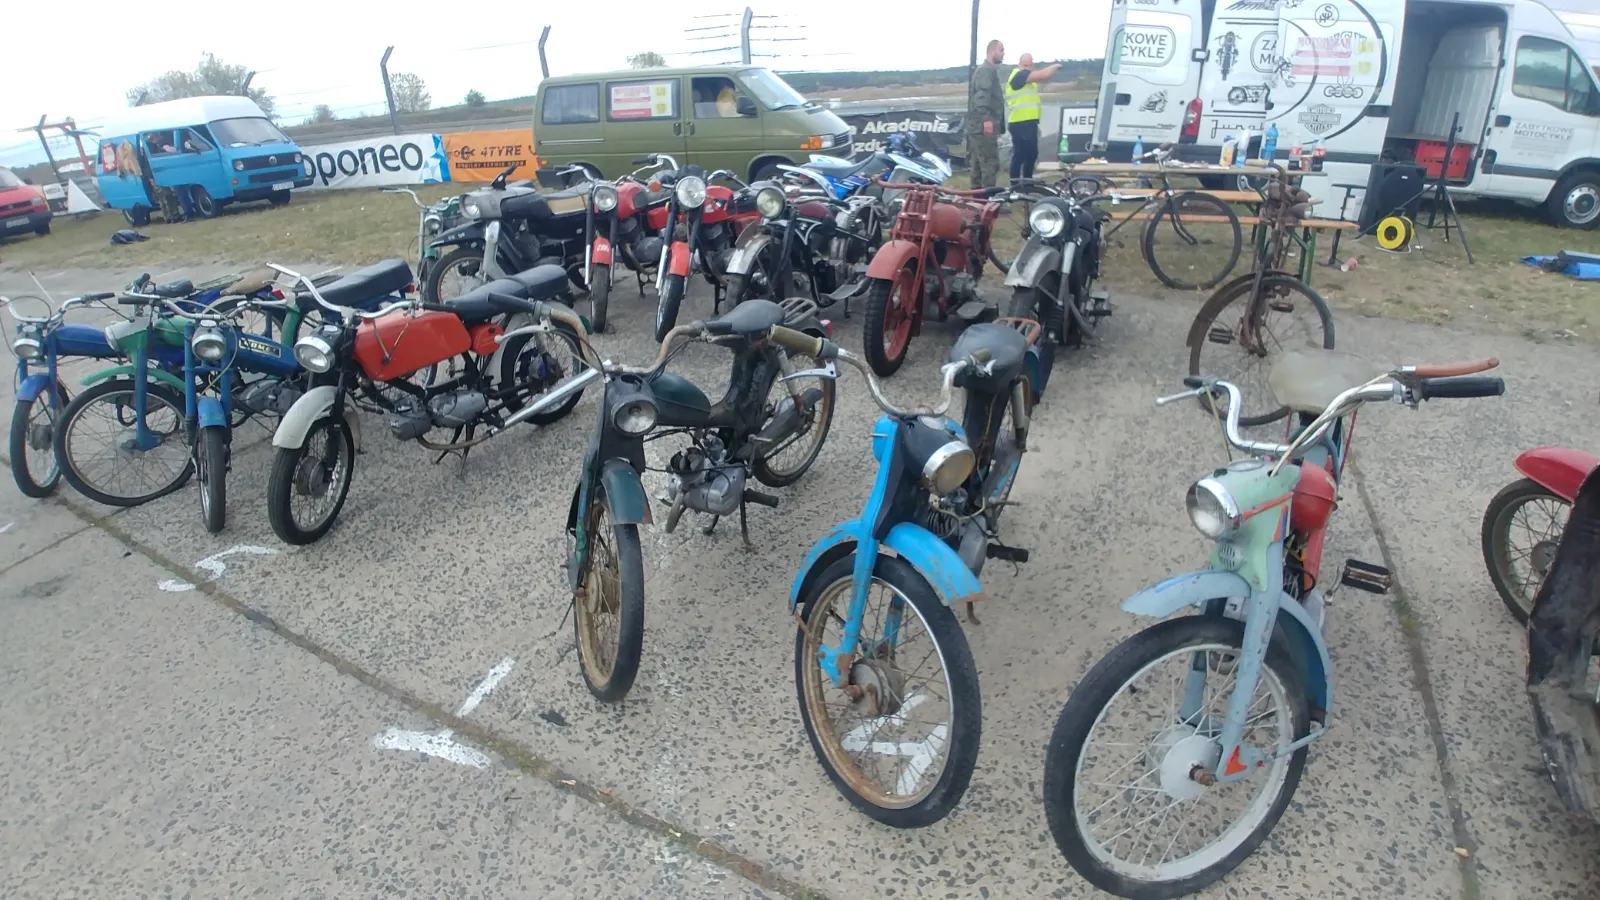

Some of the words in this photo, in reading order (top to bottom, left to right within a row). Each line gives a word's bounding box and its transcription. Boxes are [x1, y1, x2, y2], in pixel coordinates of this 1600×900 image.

[1124, 32, 1168, 46] KOWE
[1120, 45, 1166, 59] CYKLE
[862, 118, 949, 135] Akademia
[1513, 129, 1573, 141] MOTOCYKLE
[480, 145, 522, 157] 4TYRE
